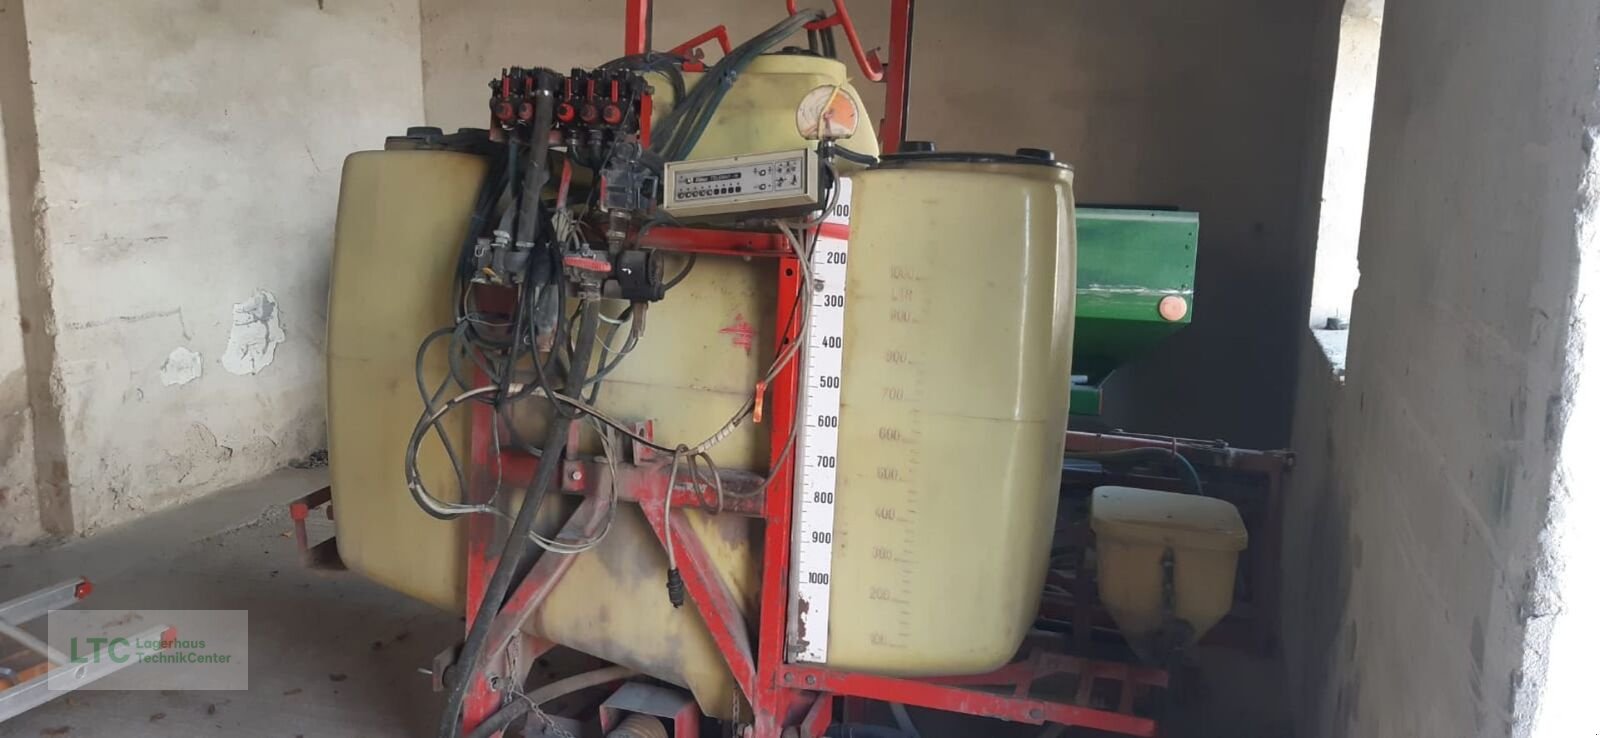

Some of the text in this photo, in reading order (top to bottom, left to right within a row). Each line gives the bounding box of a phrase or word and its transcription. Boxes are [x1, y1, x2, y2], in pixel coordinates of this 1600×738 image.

[831, 204, 850, 217] 100
[827, 252, 847, 264] 200
[824, 295, 844, 307] 300
[822, 336, 842, 349] 400
[819, 376, 840, 389] 500
[817, 415, 838, 428] 600
[816, 455, 836, 468] 700
[813, 491, 834, 504] 800
[811, 531, 832, 544] 900
[808, 572, 829, 585] 1000
